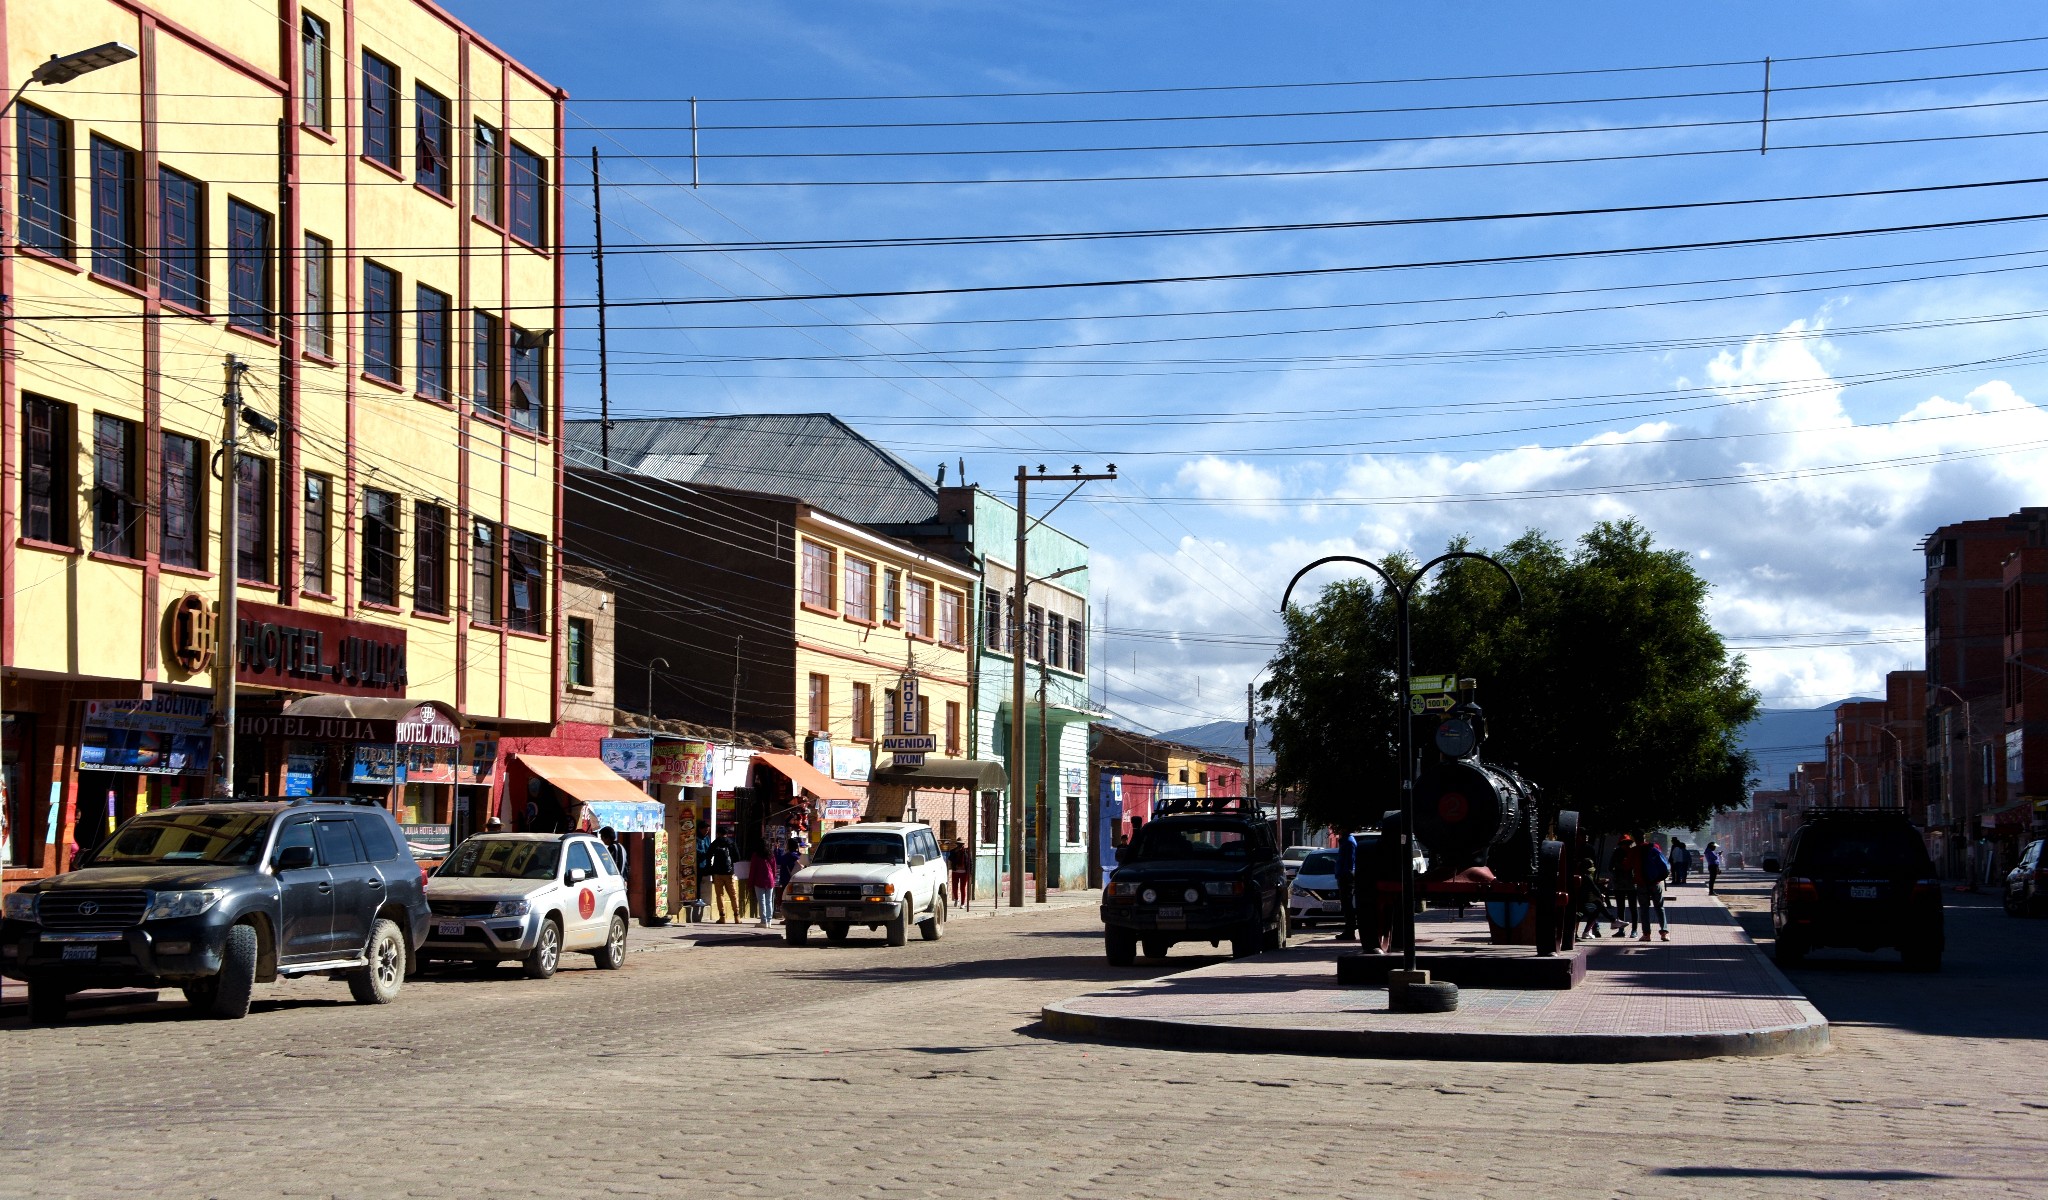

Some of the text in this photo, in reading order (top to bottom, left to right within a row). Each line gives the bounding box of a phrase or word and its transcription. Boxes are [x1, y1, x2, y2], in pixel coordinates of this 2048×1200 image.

[239, 618, 408, 686] HOTEL JULIA
[156, 695, 202, 717] BOLIVIA
[903, 681, 914, 732] HOTEL
[1412, 698, 1424, 709] 5%
[1428, 699, 1440, 707] 100
[239, 716, 376, 741] HOTEL JULIA
[396, 722, 455, 745] HOTEL JULIA
[883, 738, 932, 749] AVENIDA
[664, 756, 689, 773] BON
[894, 754, 921, 764] UYUNI
[404, 826, 419, 835] JULIA
